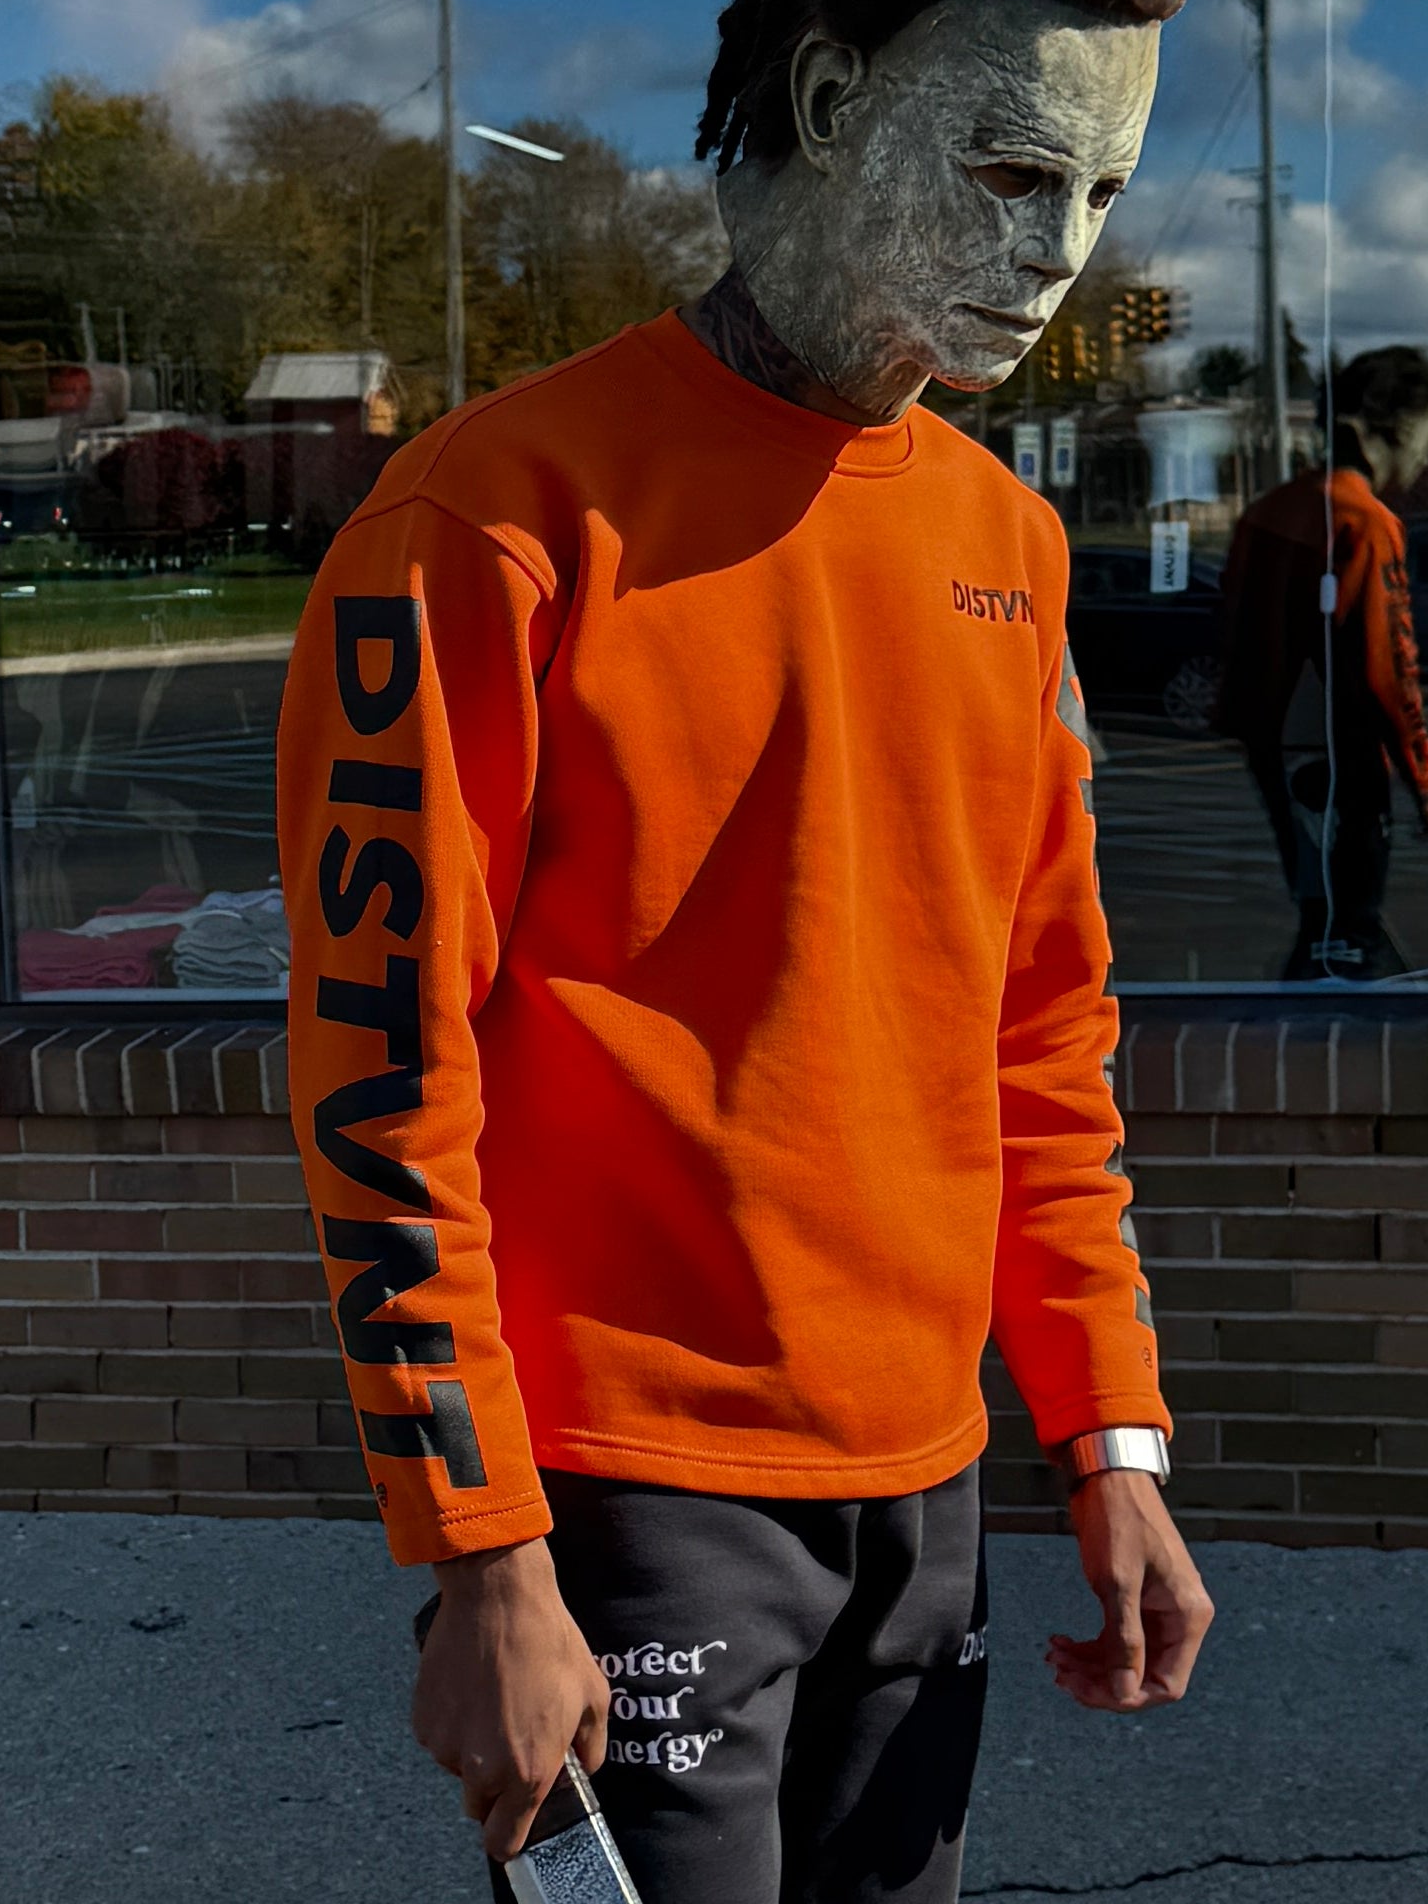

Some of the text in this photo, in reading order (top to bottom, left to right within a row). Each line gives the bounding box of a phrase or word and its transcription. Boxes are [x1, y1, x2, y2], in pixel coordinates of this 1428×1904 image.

[951, 579, 1035, 624] DISTVN
[313, 595, 489, 1488] DISTVNT
[593, 1640, 727, 1678] otect
[608, 1728, 724, 1773] nergy
